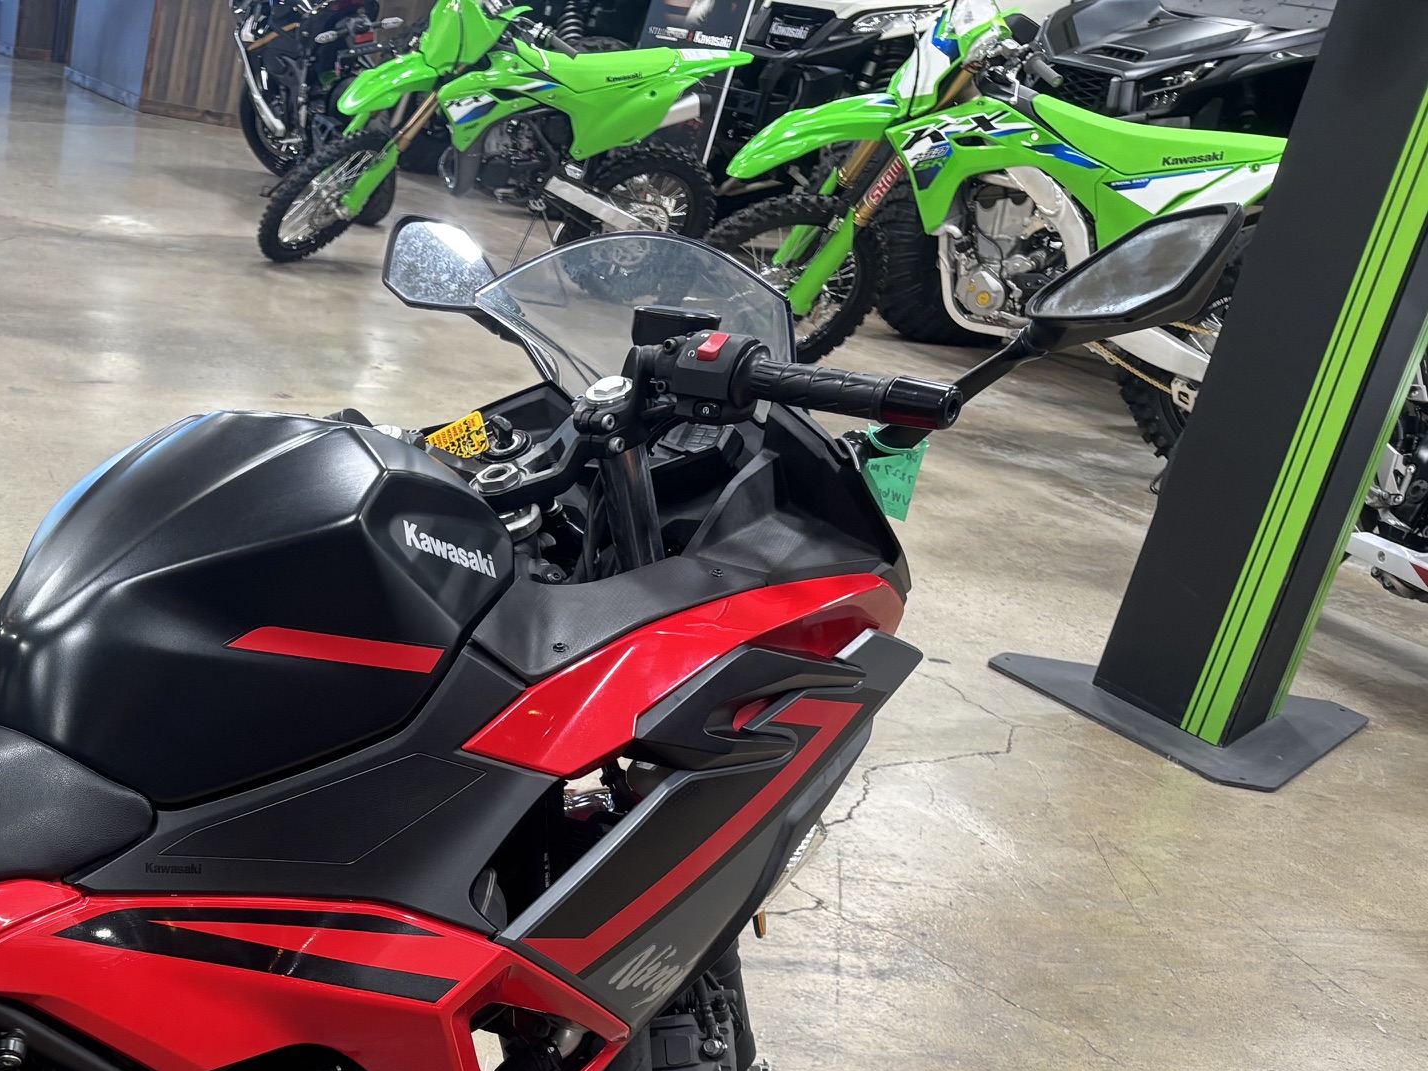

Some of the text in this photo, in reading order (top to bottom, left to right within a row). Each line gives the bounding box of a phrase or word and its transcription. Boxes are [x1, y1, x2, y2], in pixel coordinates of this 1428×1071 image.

[693, 30, 733, 49] Kawasaki
[1161, 151, 1225, 167] Kawasaki
[402, 519, 497, 579] Kawasaki
[145, 862, 202, 874] Kawasaki
